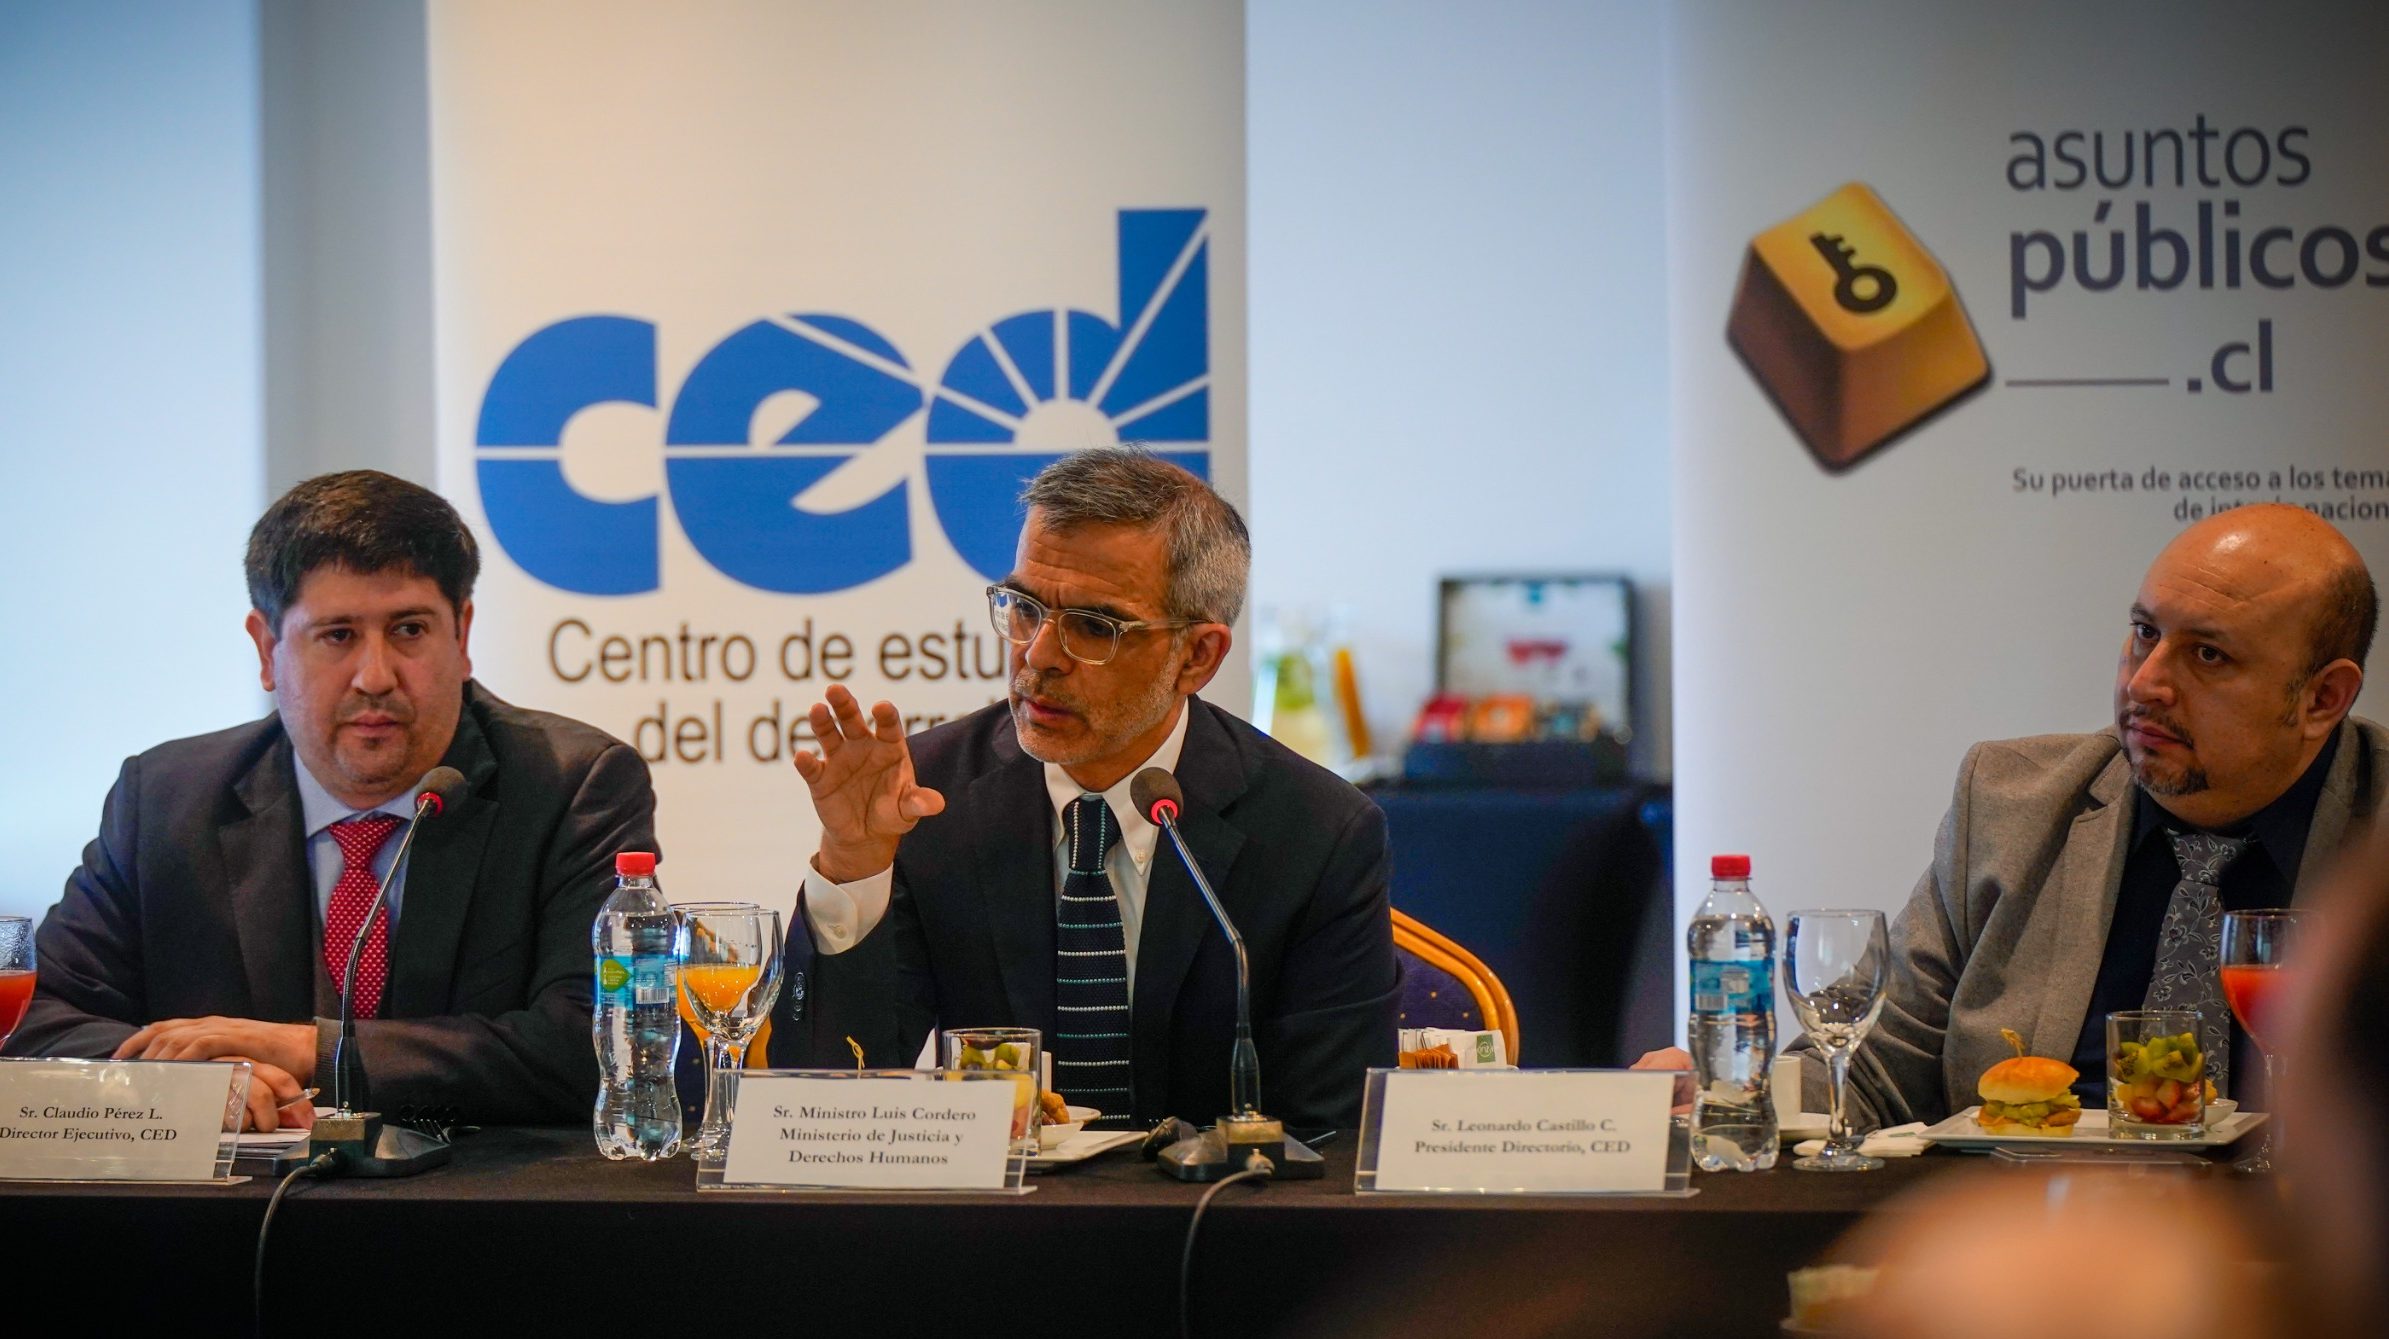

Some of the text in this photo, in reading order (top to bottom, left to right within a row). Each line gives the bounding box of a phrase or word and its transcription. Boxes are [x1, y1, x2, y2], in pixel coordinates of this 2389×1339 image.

[2005, 114, 2311, 190] asuntos
[2009, 200, 2389, 319] públicos
[2186, 318, 2273, 393] .cl
[476, 208, 1211, 596] ced
[2012, 465, 2389, 497] Su puerta de acceso a los tem
[2174, 498, 2202, 521] de
[549, 617, 1006, 684] Centro de estu
[634, 700, 723, 764] del
[20, 1106, 163, 1120] Sr. Claudio Pérez L.
[772, 1105, 976, 1121] Sr. Ministro Luis Cordero
[0, 1126, 177, 1142] Director Ejecutivo, CED
[779, 1127, 964, 1146] Ministerio de Justicia y
[1431, 1118, 1617, 1132] Sr. Leonardo Castillo C.
[788, 1150, 949, 1165] Derechos Humanos
[1414, 1140, 1632, 1155] Presidente Directorio, CED
